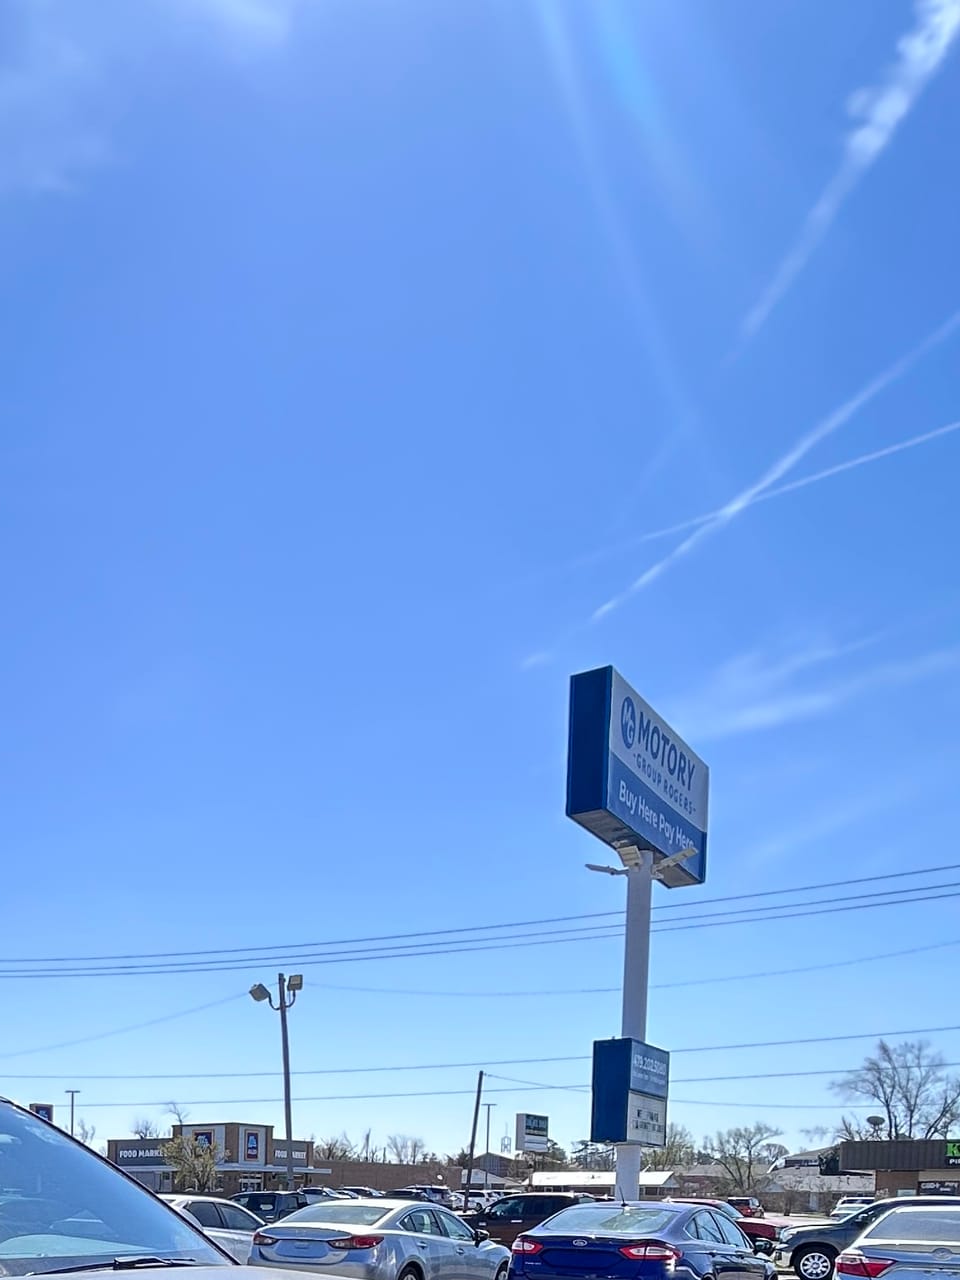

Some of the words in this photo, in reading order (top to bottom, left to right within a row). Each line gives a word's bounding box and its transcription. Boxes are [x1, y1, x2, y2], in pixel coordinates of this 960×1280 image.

[637, 711, 695, 791] MOTORY
[619, 779, 637, 815] Buy
[638, 795, 658, 827] Here
[658, 812, 675, 842] Pay
[119, 1150, 137, 1158] FOOD
[138, 1149, 167, 1157] MARKE
[274, 1150, 288, 1159] FOOD
[291, 1151, 307, 1160] ARKET
